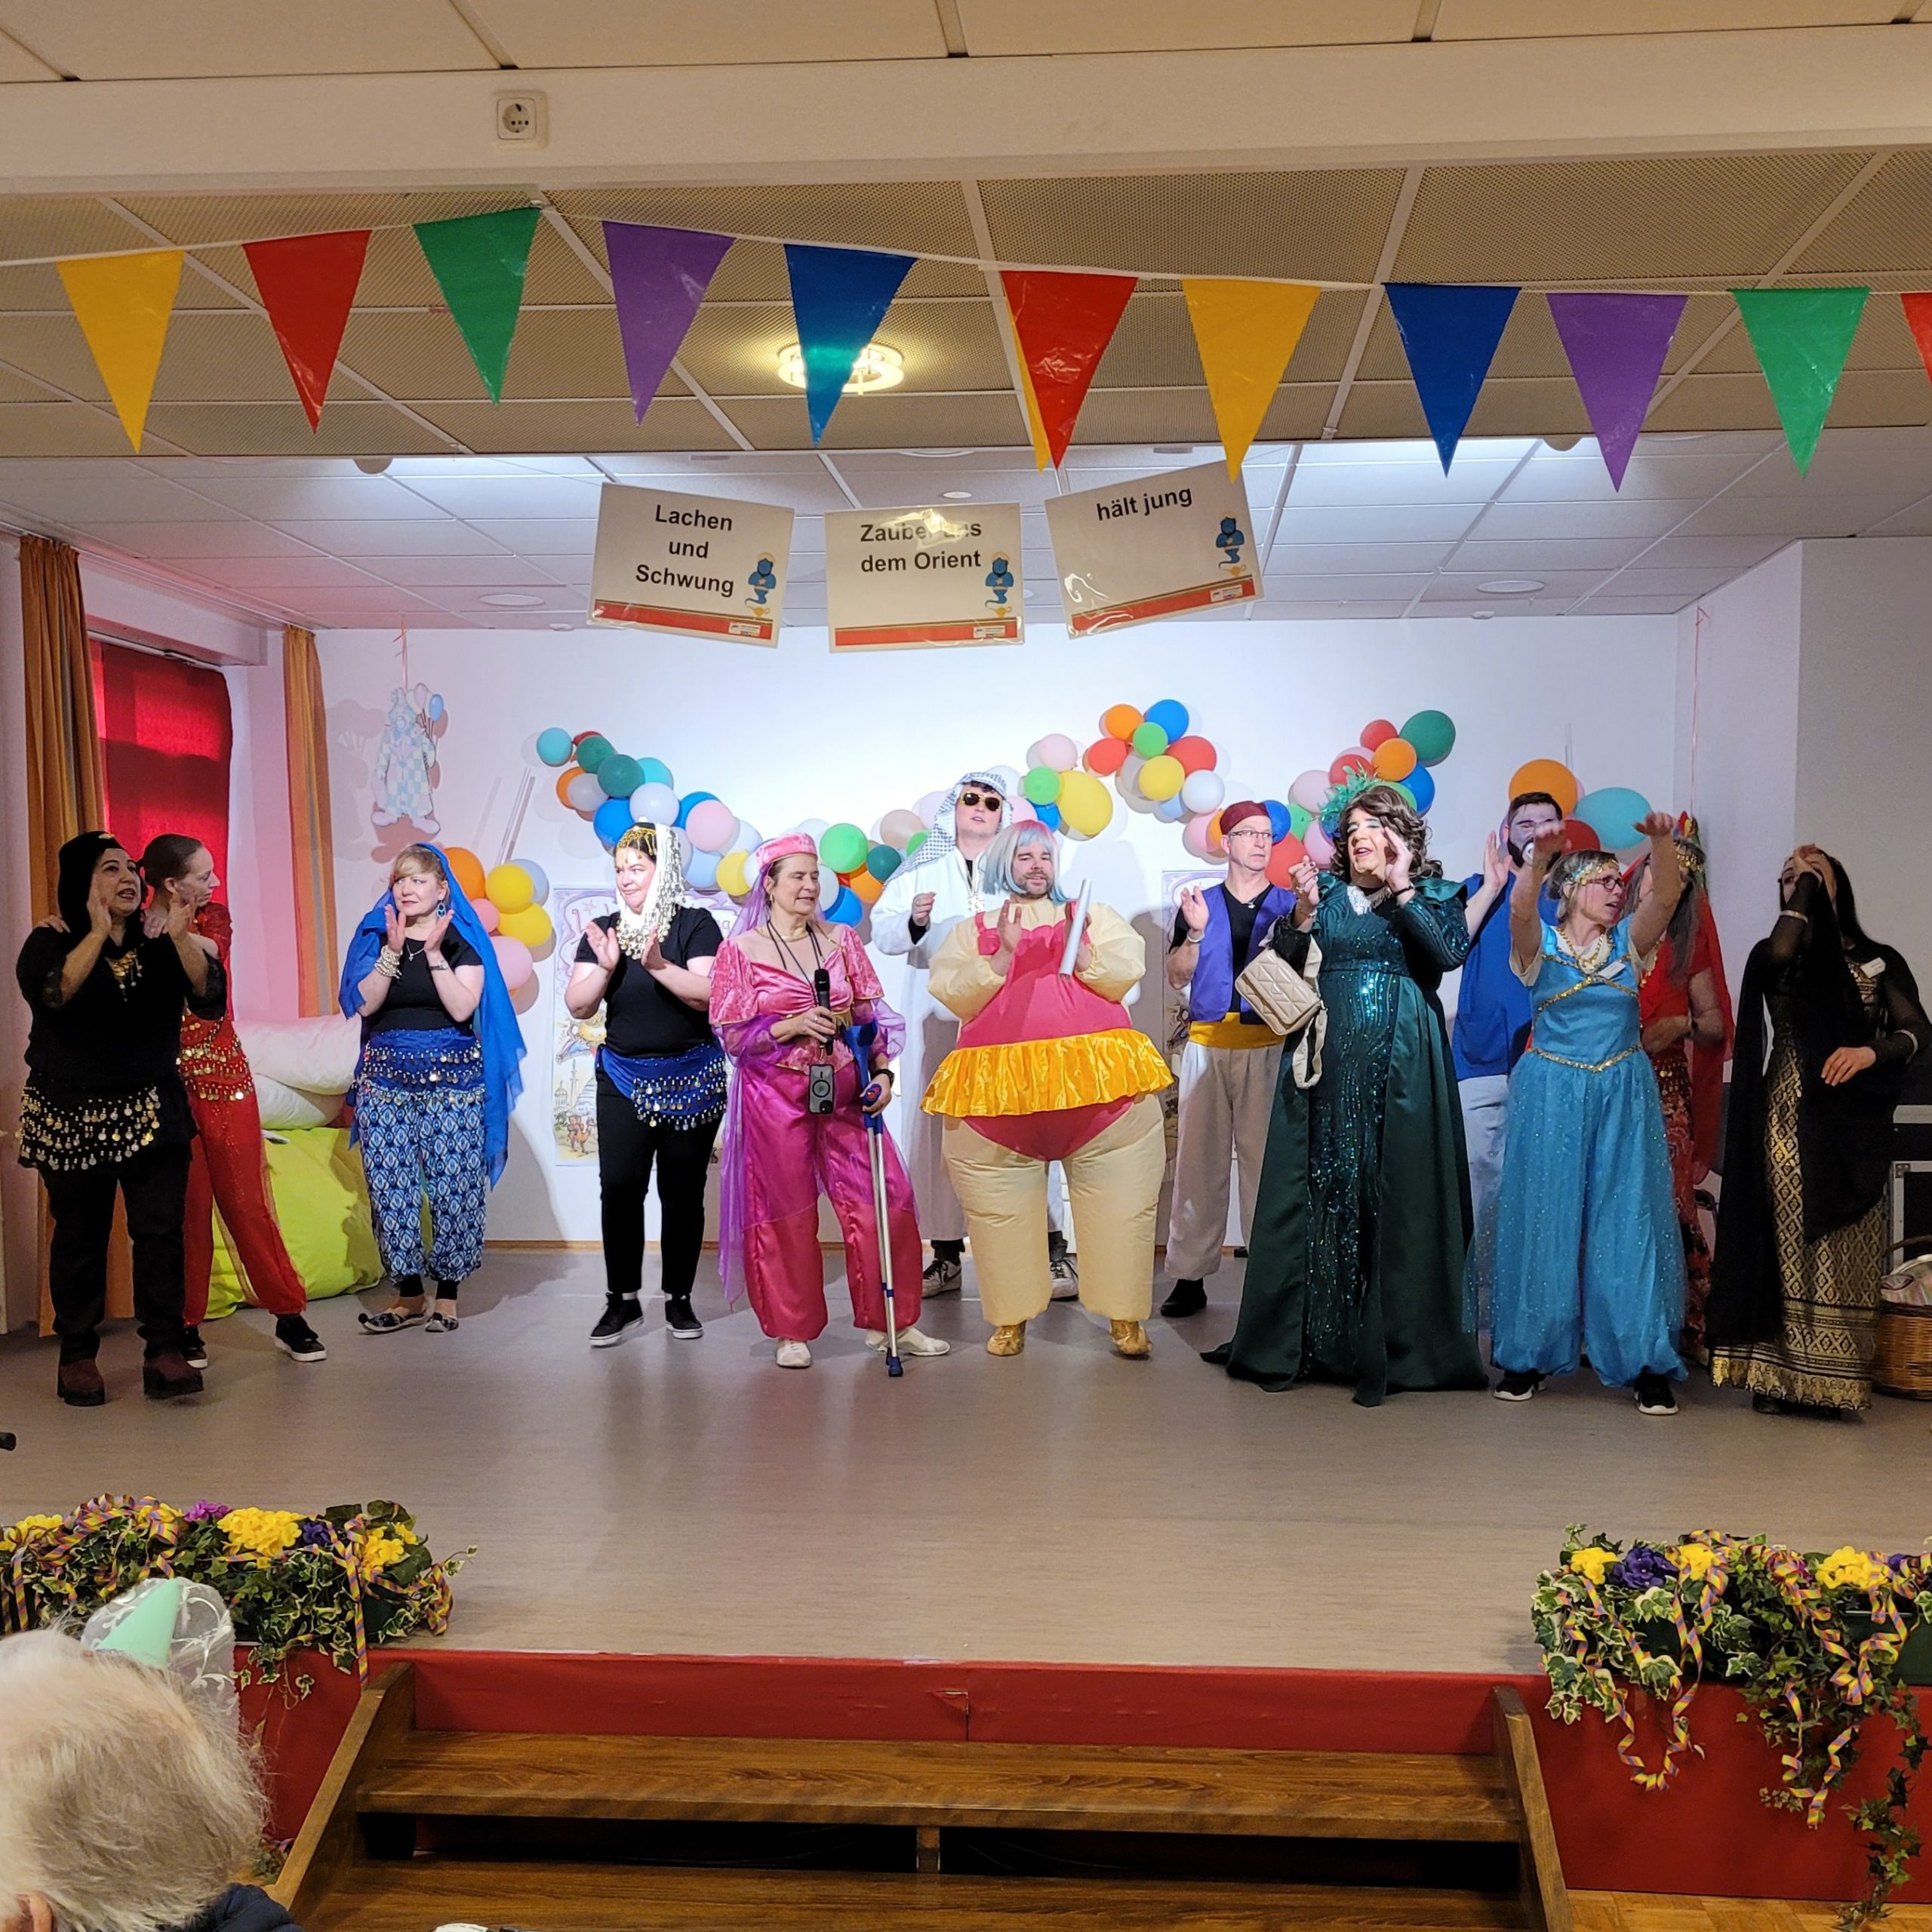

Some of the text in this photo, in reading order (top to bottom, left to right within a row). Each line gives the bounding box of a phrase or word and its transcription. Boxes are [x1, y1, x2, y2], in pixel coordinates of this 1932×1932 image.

[654, 504, 733, 531] Lachen
[1097, 488, 1193, 521] hält jung
[669, 540, 709, 559] und
[860, 549, 982, 573] dem Orient
[635, 563, 734, 598] Schwung
